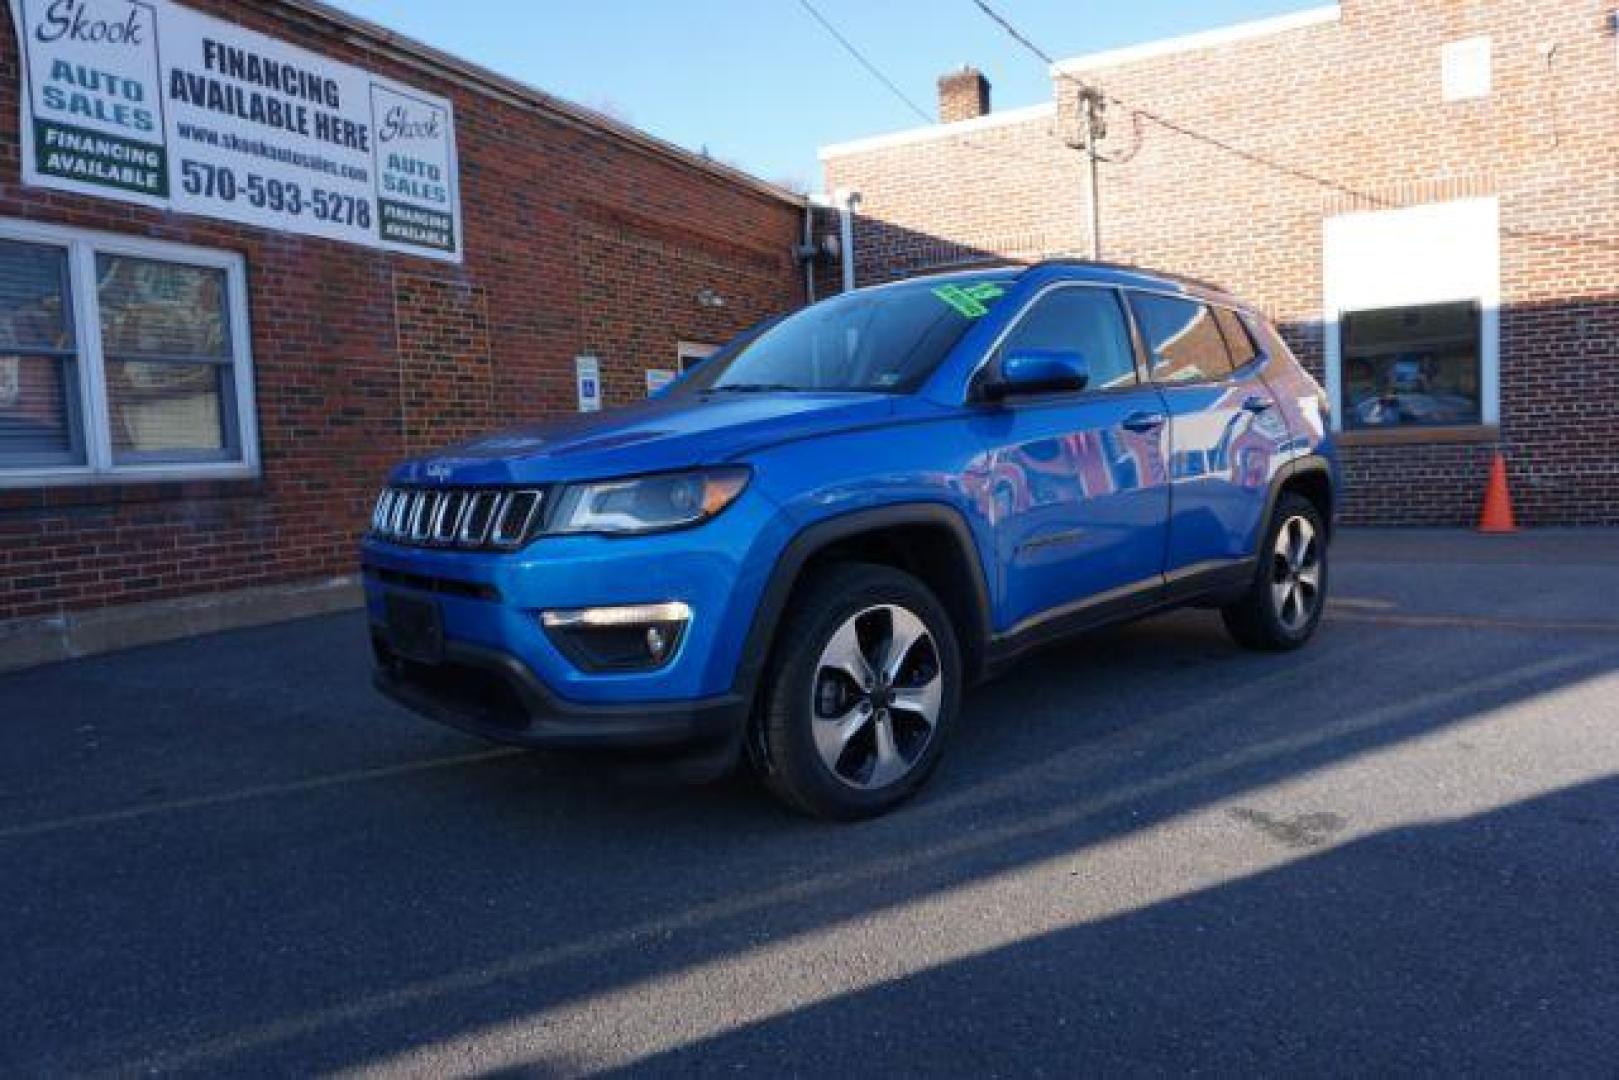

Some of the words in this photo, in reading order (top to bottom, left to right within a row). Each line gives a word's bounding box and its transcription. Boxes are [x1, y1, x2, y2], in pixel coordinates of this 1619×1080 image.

[37, 0, 142, 44] Skook
[51, 60, 144, 101] AUTO
[202, 38, 340, 109] FINANCING
[43, 86, 152, 130] SALES
[170, 68, 309, 136] AVAILABLE
[314, 111, 370, 152] HERE
[379, 105, 440, 142] Skook
[45, 128, 159, 168] FINANCING
[388, 153, 440, 181] AUTO
[47, 153, 158, 188] AVAILABLE
[383, 173, 446, 203] SALES
[181, 159, 370, 229] 570-593-5278
